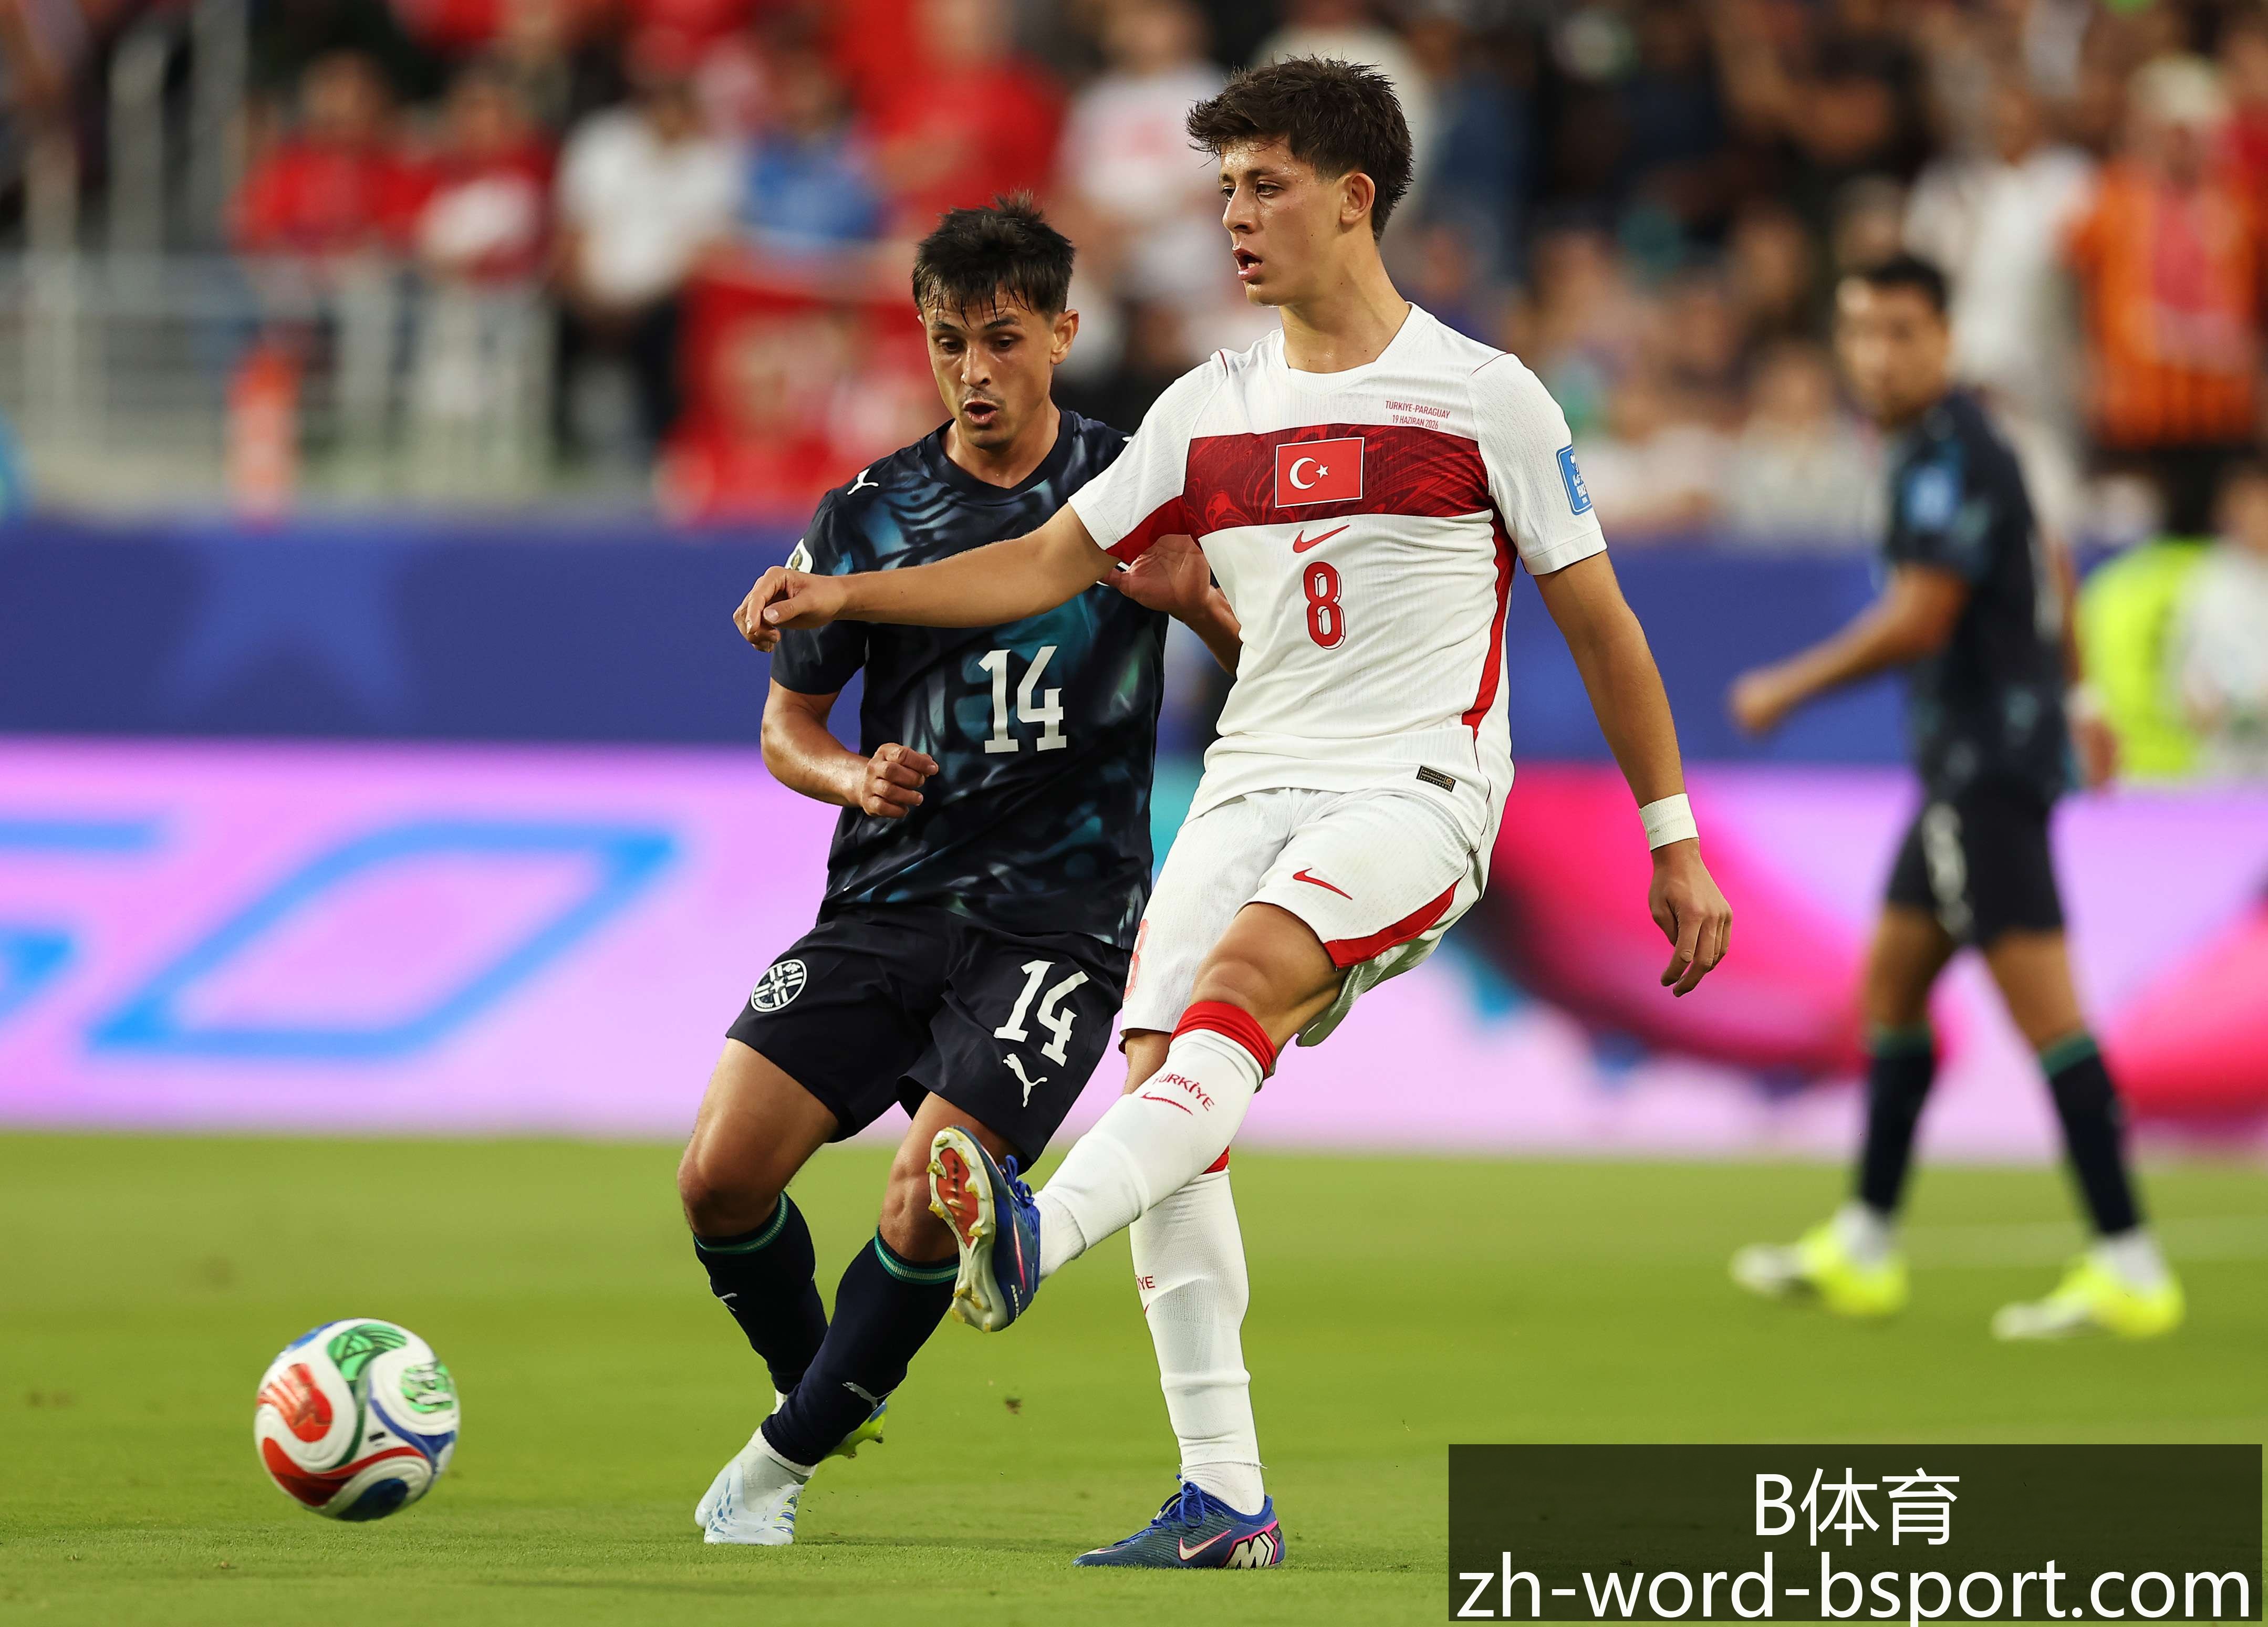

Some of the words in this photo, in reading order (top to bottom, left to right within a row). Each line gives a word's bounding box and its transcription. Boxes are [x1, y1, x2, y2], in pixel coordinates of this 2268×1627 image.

[1386, 399, 1450, 419] TÜRKİYE-PARAGUAY
[1392, 414, 1399, 423] 19
[1399, 415, 1424, 426] HAZİRAN
[1425, 419, 1439, 430] 2026
[1303, 561, 1346, 650] 8
[977, 646, 1067, 754] 14
[993, 959, 1089, 1067] 14
